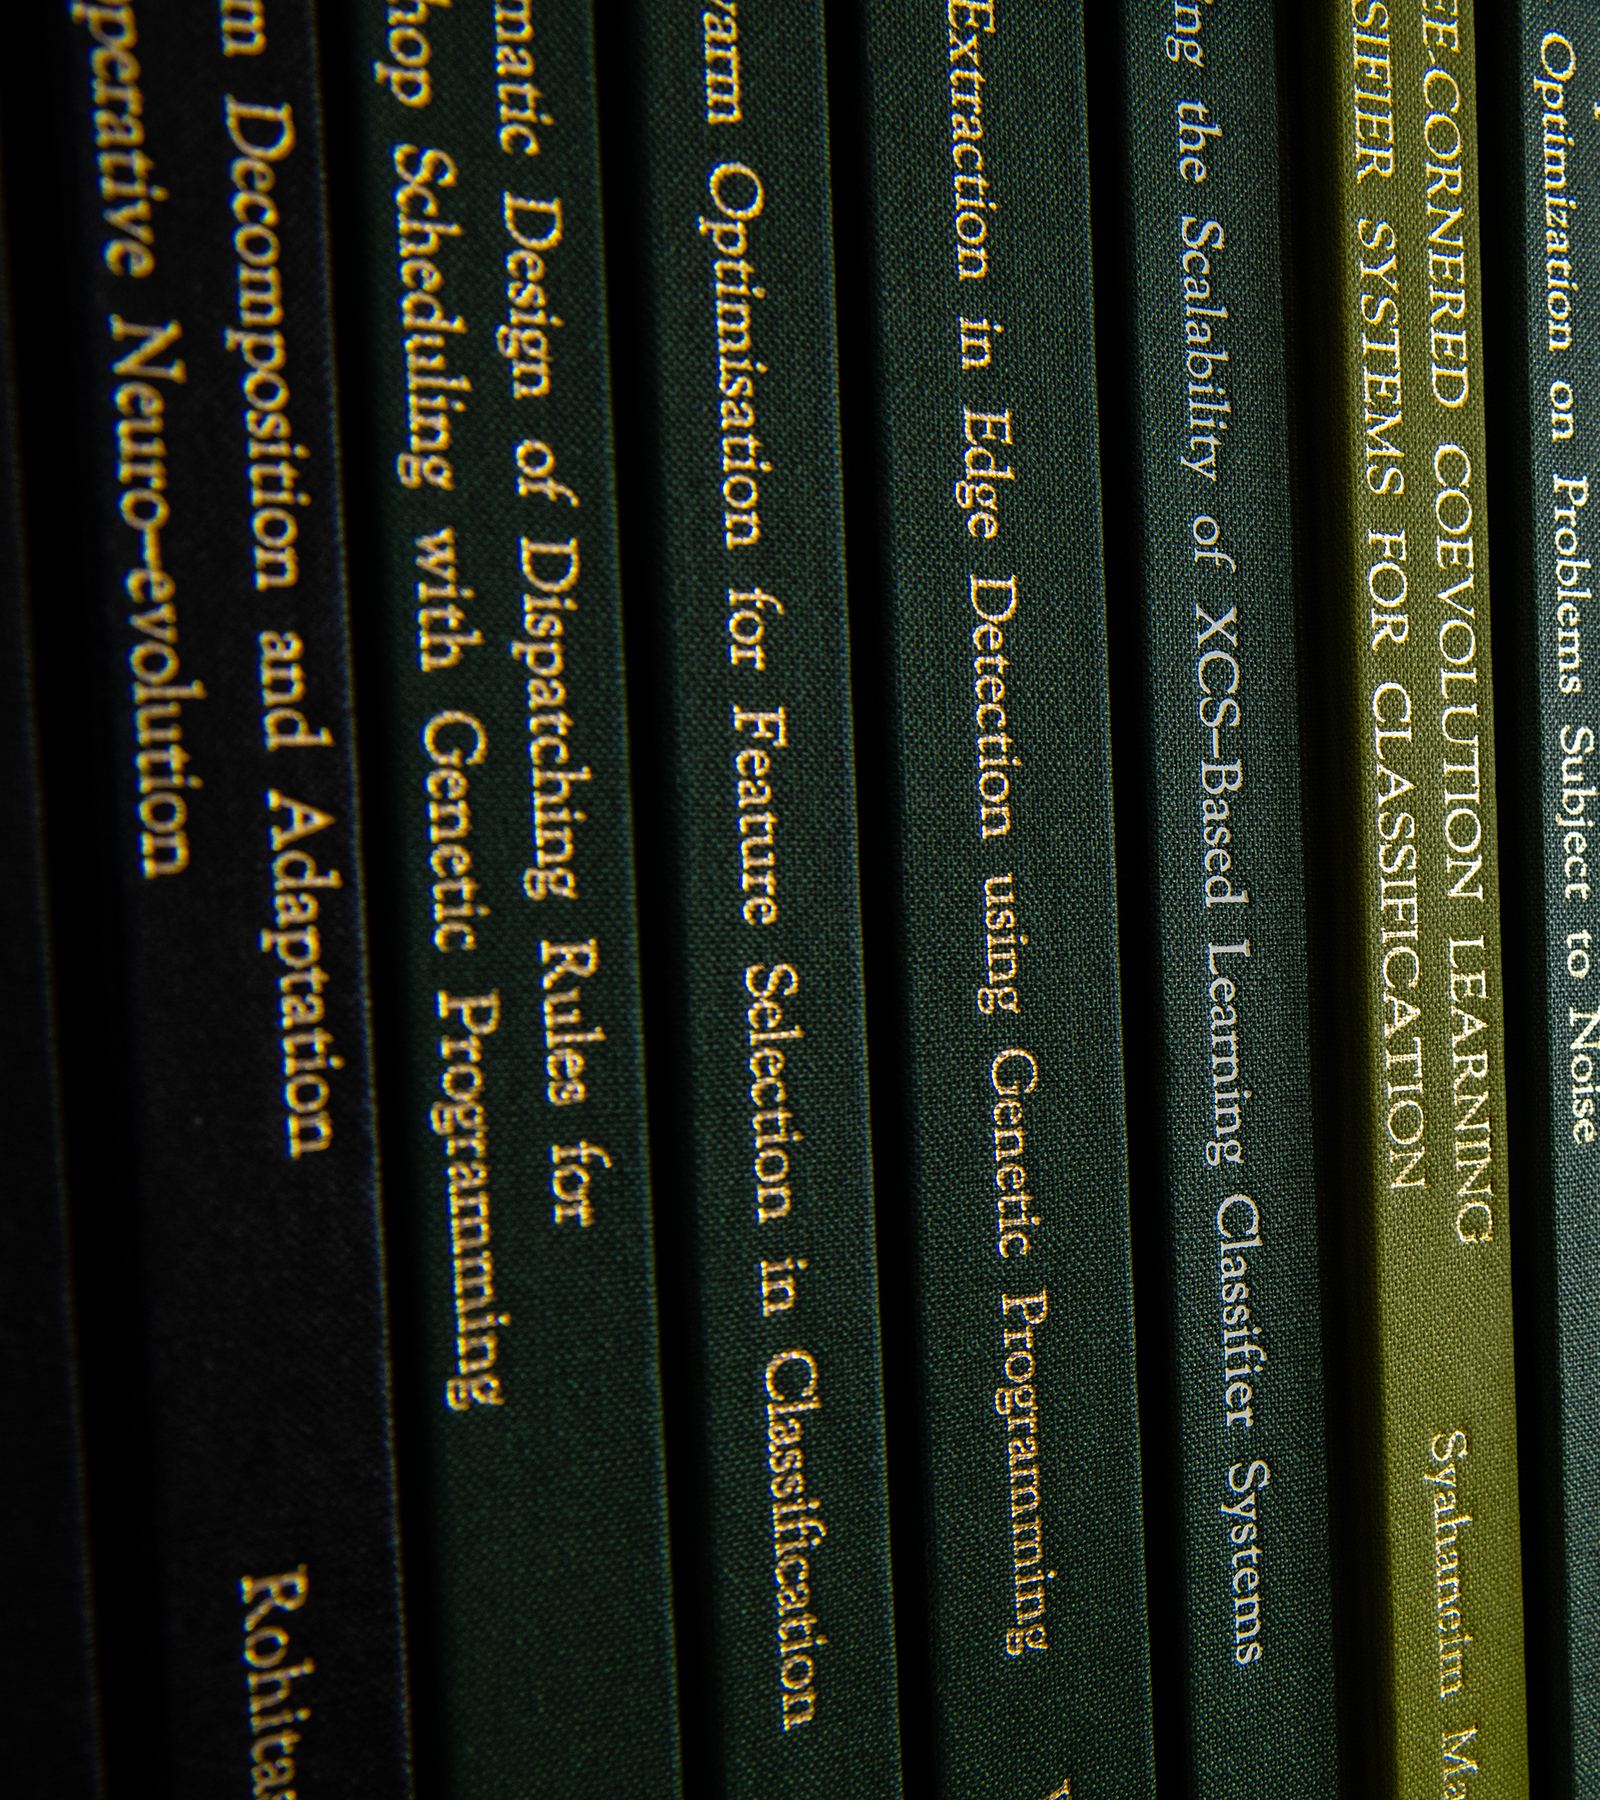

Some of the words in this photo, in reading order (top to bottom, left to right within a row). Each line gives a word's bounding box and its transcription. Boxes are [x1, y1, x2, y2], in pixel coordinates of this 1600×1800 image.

[948, 0, 1002, 280] Extraction
[1175, 101, 1223, 185] the
[1532, 31, 1574, 351] Optimization
[224, 94, 310, 591] Decomposition
[393, 144, 472, 492] Scheduling
[496, 191, 565, 400] Design
[698, 162, 772, 549] Optimisation
[958, 314, 1004, 370] in
[1178, 216, 1234, 483] Scalability
[1357, 218, 1406, 496] SYSTEMS
[515, 439, 581, 507] of
[953, 405, 1016, 541] Edge
[1548, 380, 1574, 442] on
[111, 315, 206, 879] Neuro-evolution
[414, 528, 486, 672] with
[726, 587, 783, 672] for
[1193, 515, 1237, 571] of
[1366, 528, 1413, 651] FOR
[1551, 473, 1592, 695] Problems
[259, 629, 334, 751] and
[511, 538, 593, 902] Dispatching
[968, 573, 1019, 840] Detection
[1194, 603, 1250, 906] XCS-Based
[1433, 443, 1485, 902] COEVOLUTION
[421, 710, 491, 953] Genetic
[731, 705, 787, 926] Feature
[1556, 724, 1595, 902] Subject
[262, 789, 345, 1159] Adaptation
[540, 938, 605, 1106] Rules
[978, 874, 1035, 1015] using
[1371, 681, 1428, 1190] CLASSIFICATION
[1564, 929, 1592, 979] to
[743, 962, 804, 1224] Selection
[989, 1046, 1039, 1259] Genetic
[1207, 940, 1258, 1166] Learning
[1446, 935, 1495, 1245] LEARNING
[430, 989, 511, 1410] Programming
[550, 1139, 612, 1227] for
[759, 1257, 808, 1317] in
[1215, 1194, 1269, 1428] Classifier
[764, 1348, 829, 1734] Classification
[994, 1288, 1058, 1657] Programming
[1221, 1459, 1272, 1665] Systems
[1430, 1431, 1472, 1700] Syahaneim
